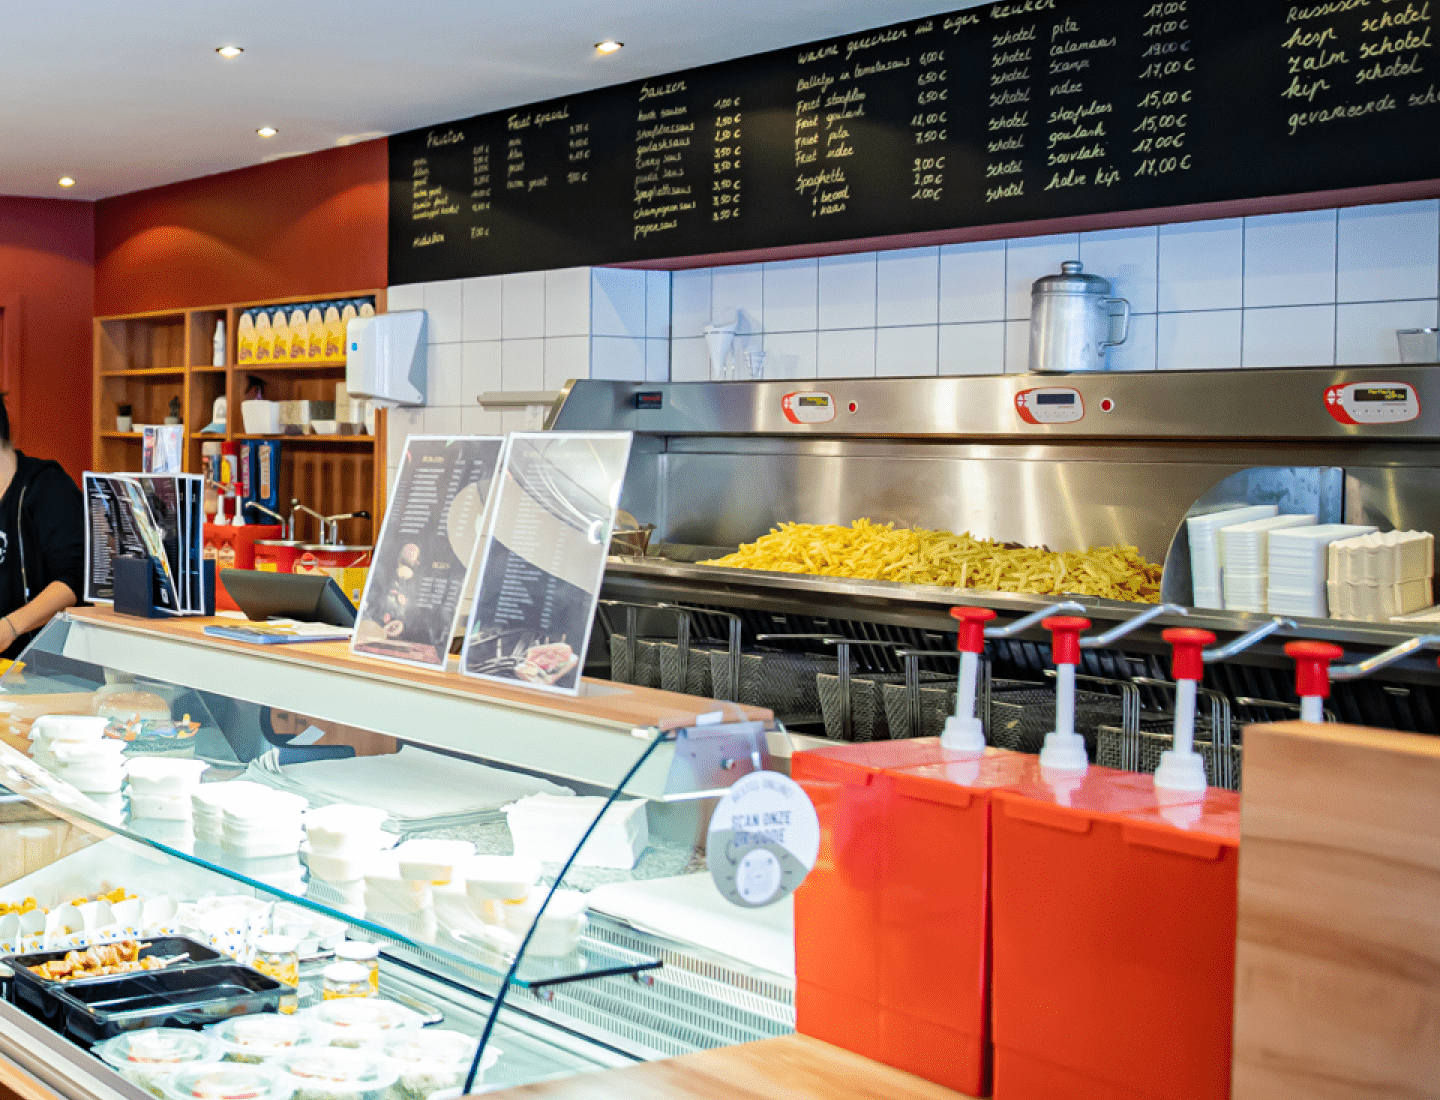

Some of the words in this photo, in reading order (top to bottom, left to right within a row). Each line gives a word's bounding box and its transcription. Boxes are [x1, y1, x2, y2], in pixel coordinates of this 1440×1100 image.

[1360, 0, 1430, 32] schotel
[1288, 50, 1349, 73] zalm
[1360, 26, 1431, 59] schotel
[1281, 76, 1330, 102] kip
[1356, 53, 1423, 84] schotel
